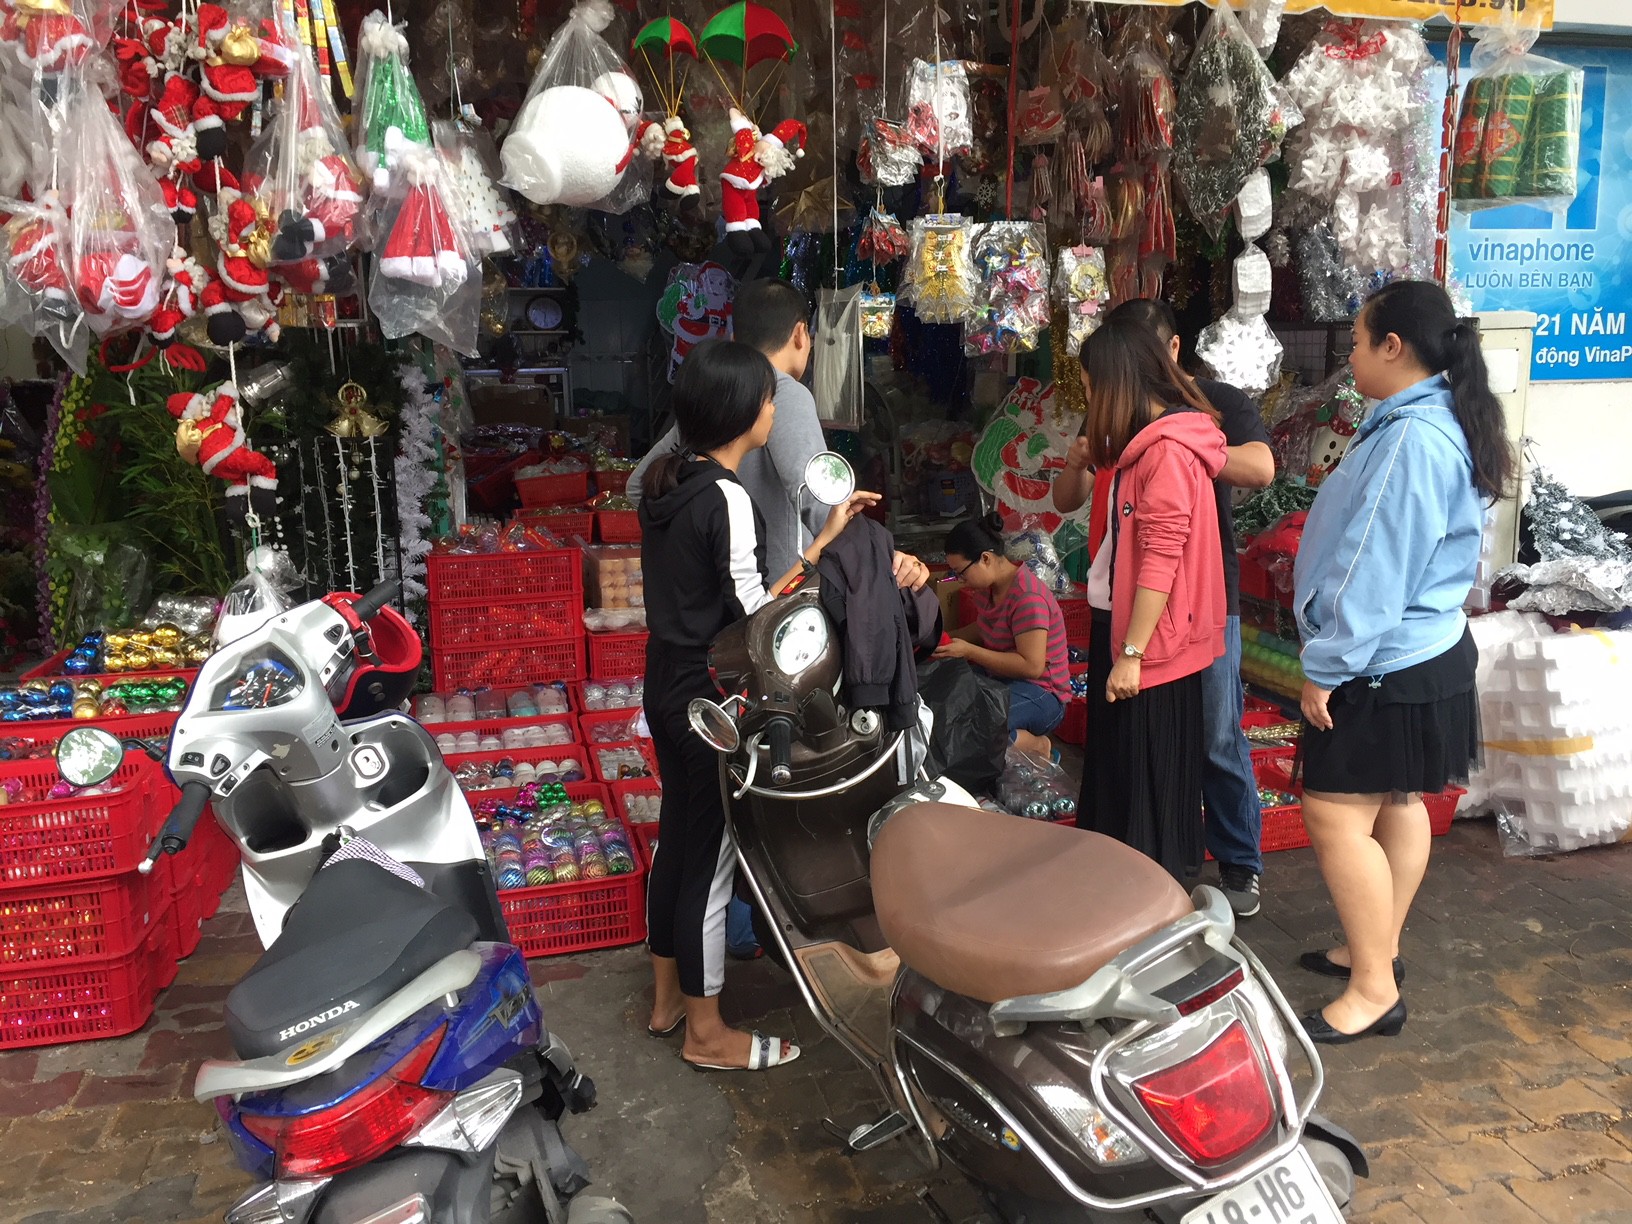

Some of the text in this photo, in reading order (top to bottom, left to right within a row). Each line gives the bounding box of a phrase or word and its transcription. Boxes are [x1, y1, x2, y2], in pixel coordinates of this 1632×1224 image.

[1469, 237, 1595, 265] vinaphone
[1465, 269, 1593, 291] LUÔN BÊN BẠN
[1536, 306, 1626, 336] 21 NĂM
[1535, 345, 1632, 368] động VinaP
[279, 1000, 361, 1041] HONDA
[1206, 1166, 1305, 1224] 8-H6
